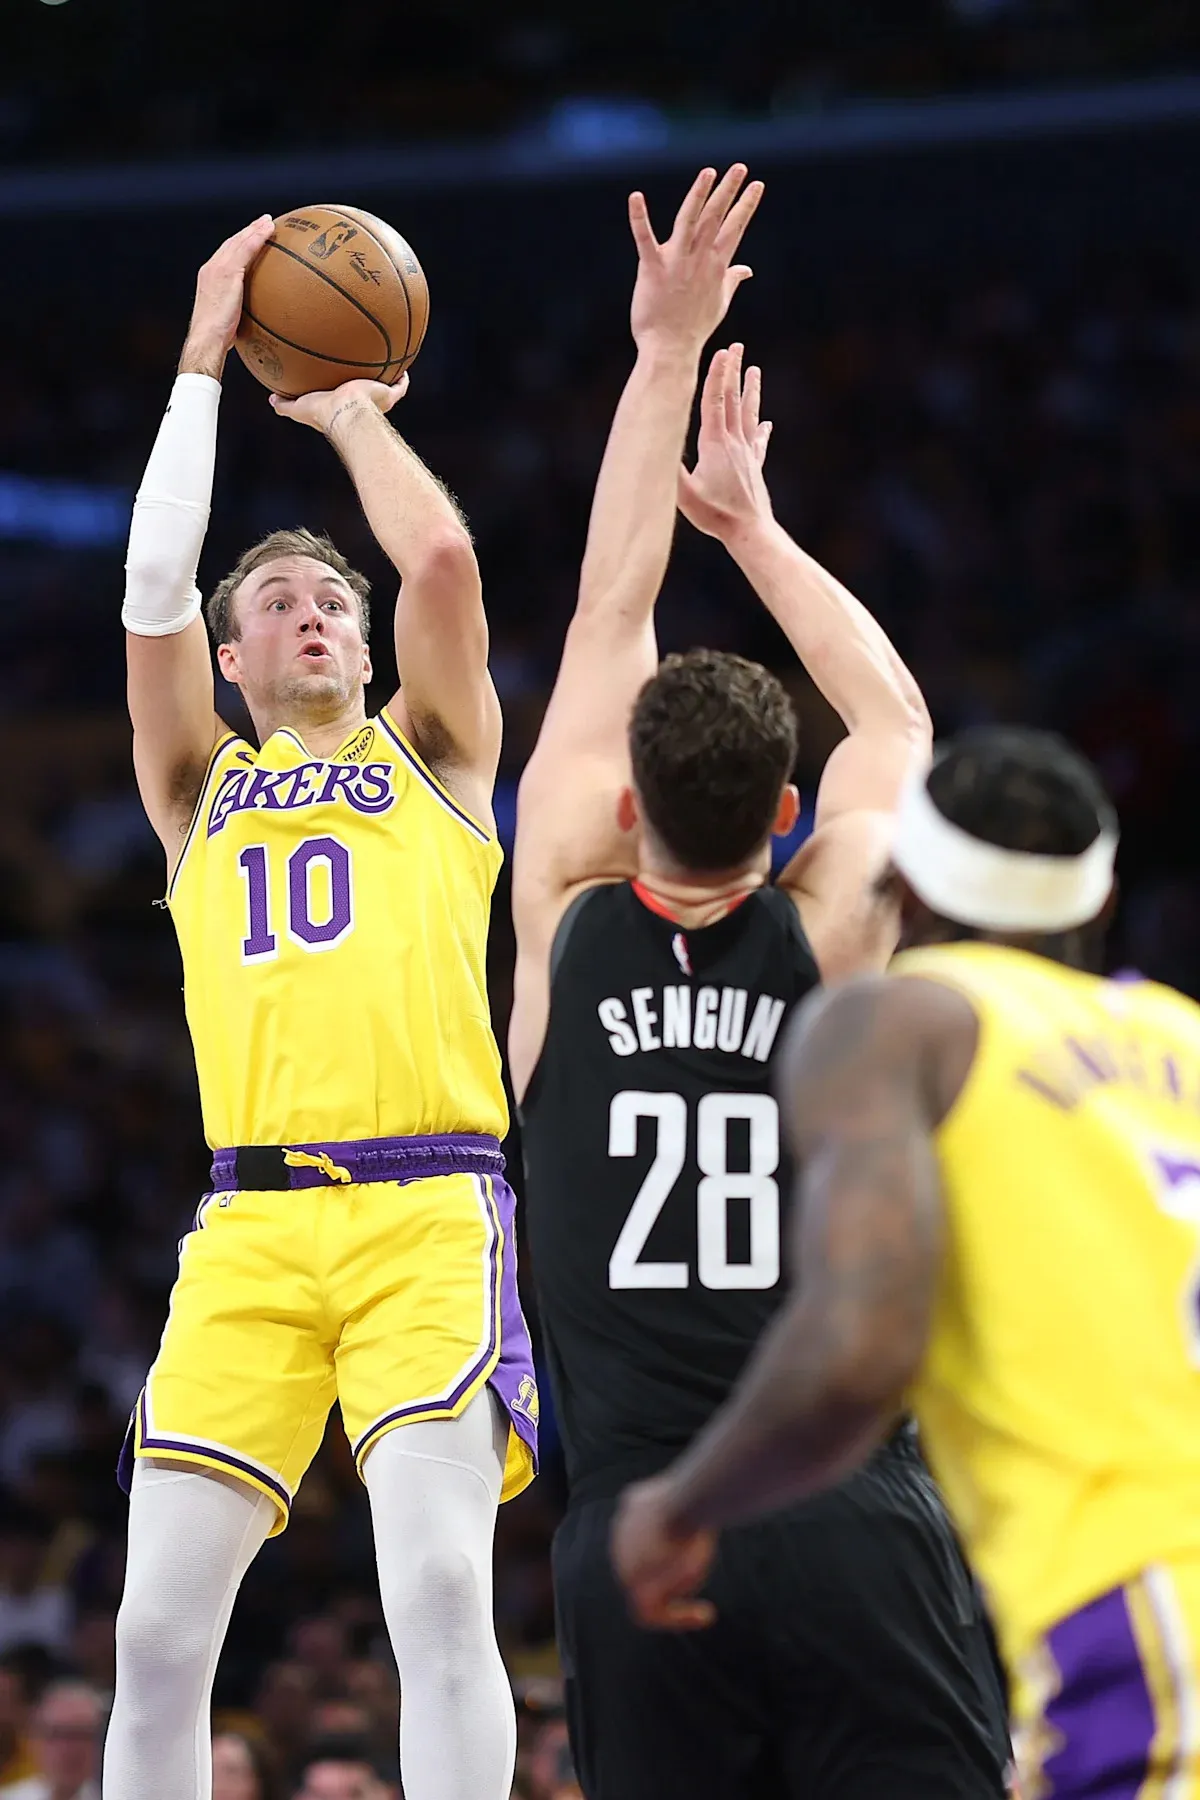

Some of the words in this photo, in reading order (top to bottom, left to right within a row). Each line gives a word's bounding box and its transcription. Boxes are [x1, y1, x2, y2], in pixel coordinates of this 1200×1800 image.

[341, 730, 372, 762] ibigo
[237, 835, 354, 964] 10
[597, 984, 786, 1063] SENGUN
[608, 1089, 780, 1290] 28
